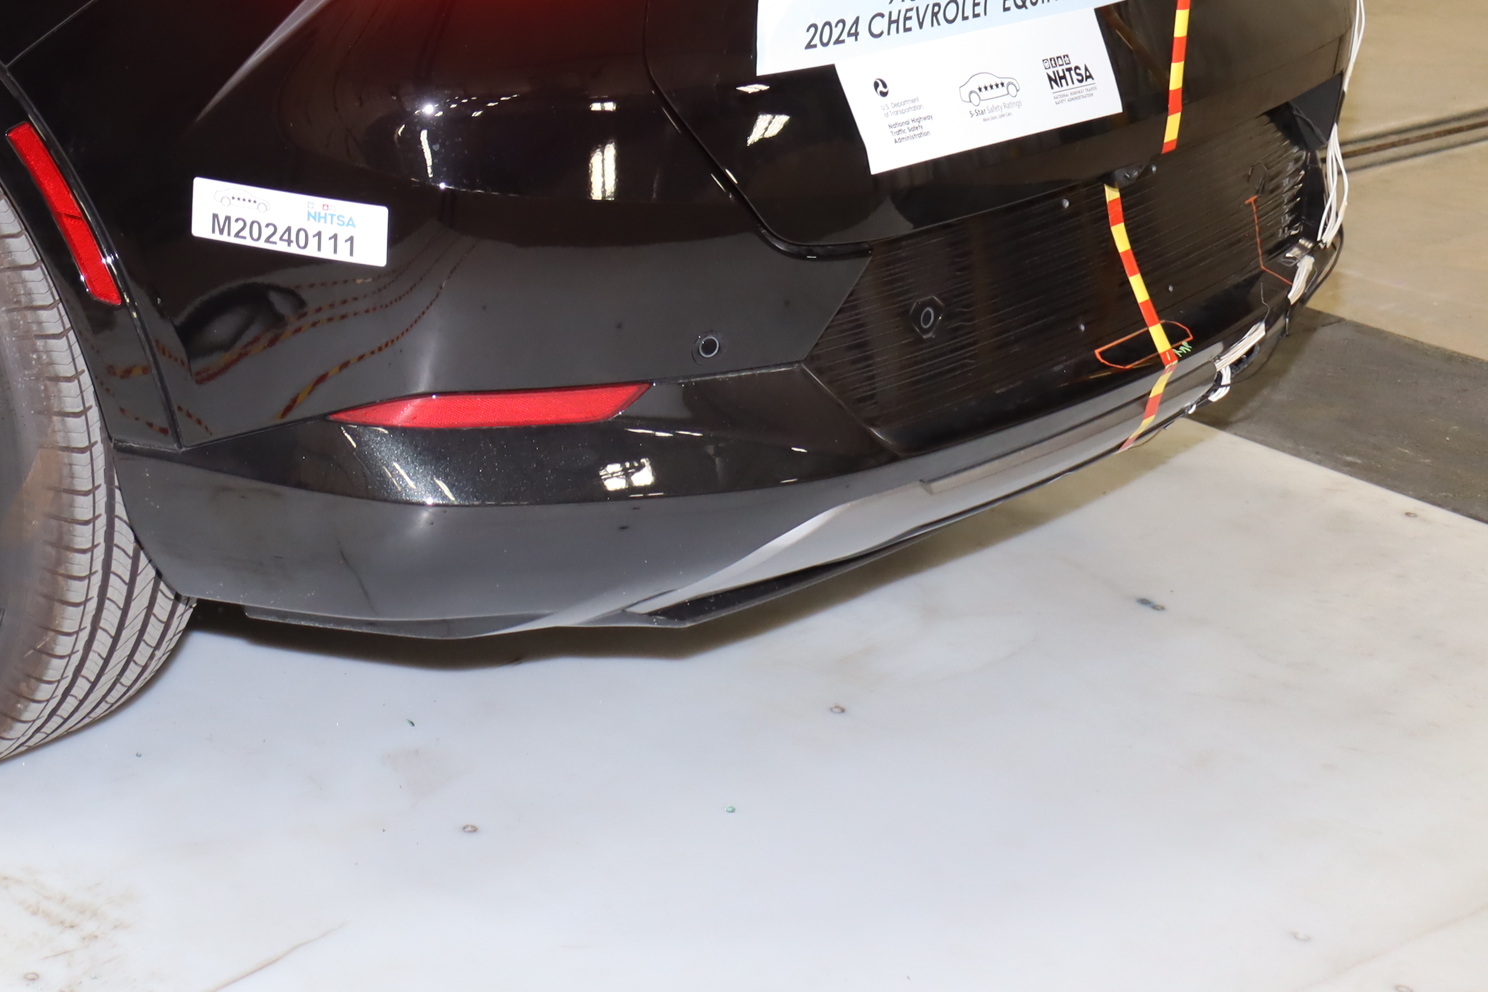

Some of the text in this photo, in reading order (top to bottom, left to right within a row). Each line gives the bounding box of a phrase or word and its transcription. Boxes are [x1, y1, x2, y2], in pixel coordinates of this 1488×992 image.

[804, 15, 860, 50] 2024
[1046, 64, 1095, 90] NHTSA
[969, 108, 986, 118] 5-Star
[887, 115, 933, 129] National Highway
[890, 124, 924, 136] Traffic Safety
[893, 130, 931, 144] Administration
[307, 210, 356, 228] NHTSA
[211, 213, 354, 257] M20240111
